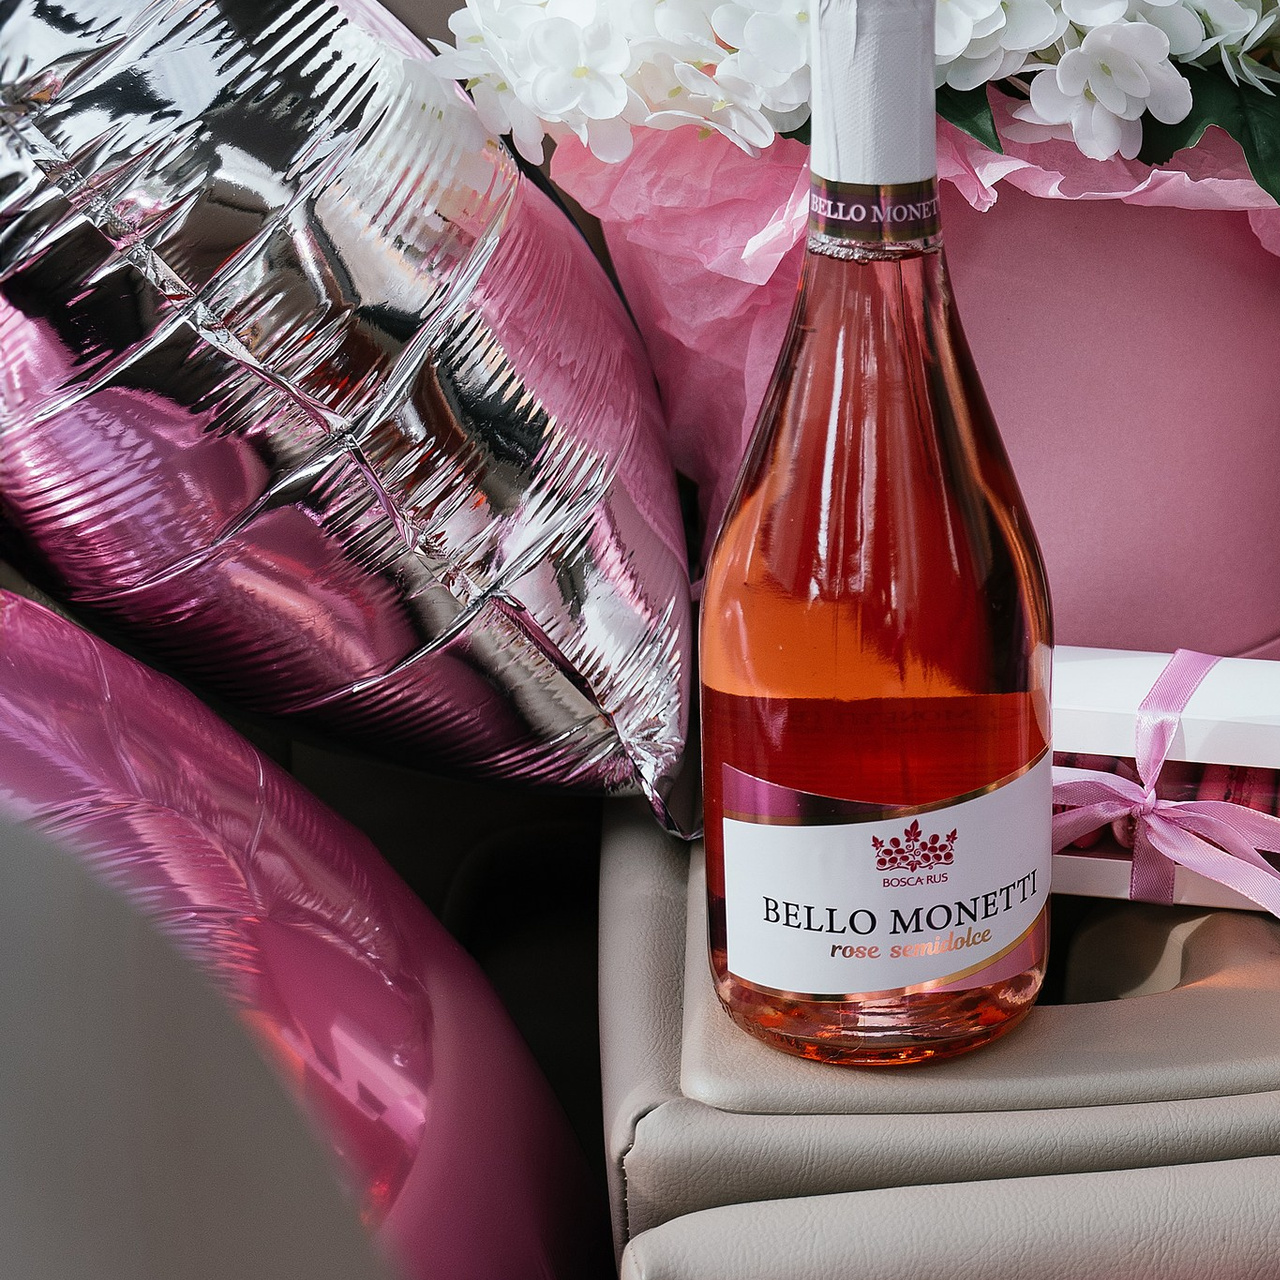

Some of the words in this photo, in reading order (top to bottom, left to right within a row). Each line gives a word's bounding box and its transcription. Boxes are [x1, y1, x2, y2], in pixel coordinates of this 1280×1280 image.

[810, 193, 867, 222] BELLO
[883, 876, 923, 887] BOSCA
[926, 873, 948, 885] RUS
[762, 896, 876, 935] BELLO
[889, 869, 1038, 935] MONETTI
[830, 943, 881, 959] rose
[889, 926, 992, 959] semidolce
